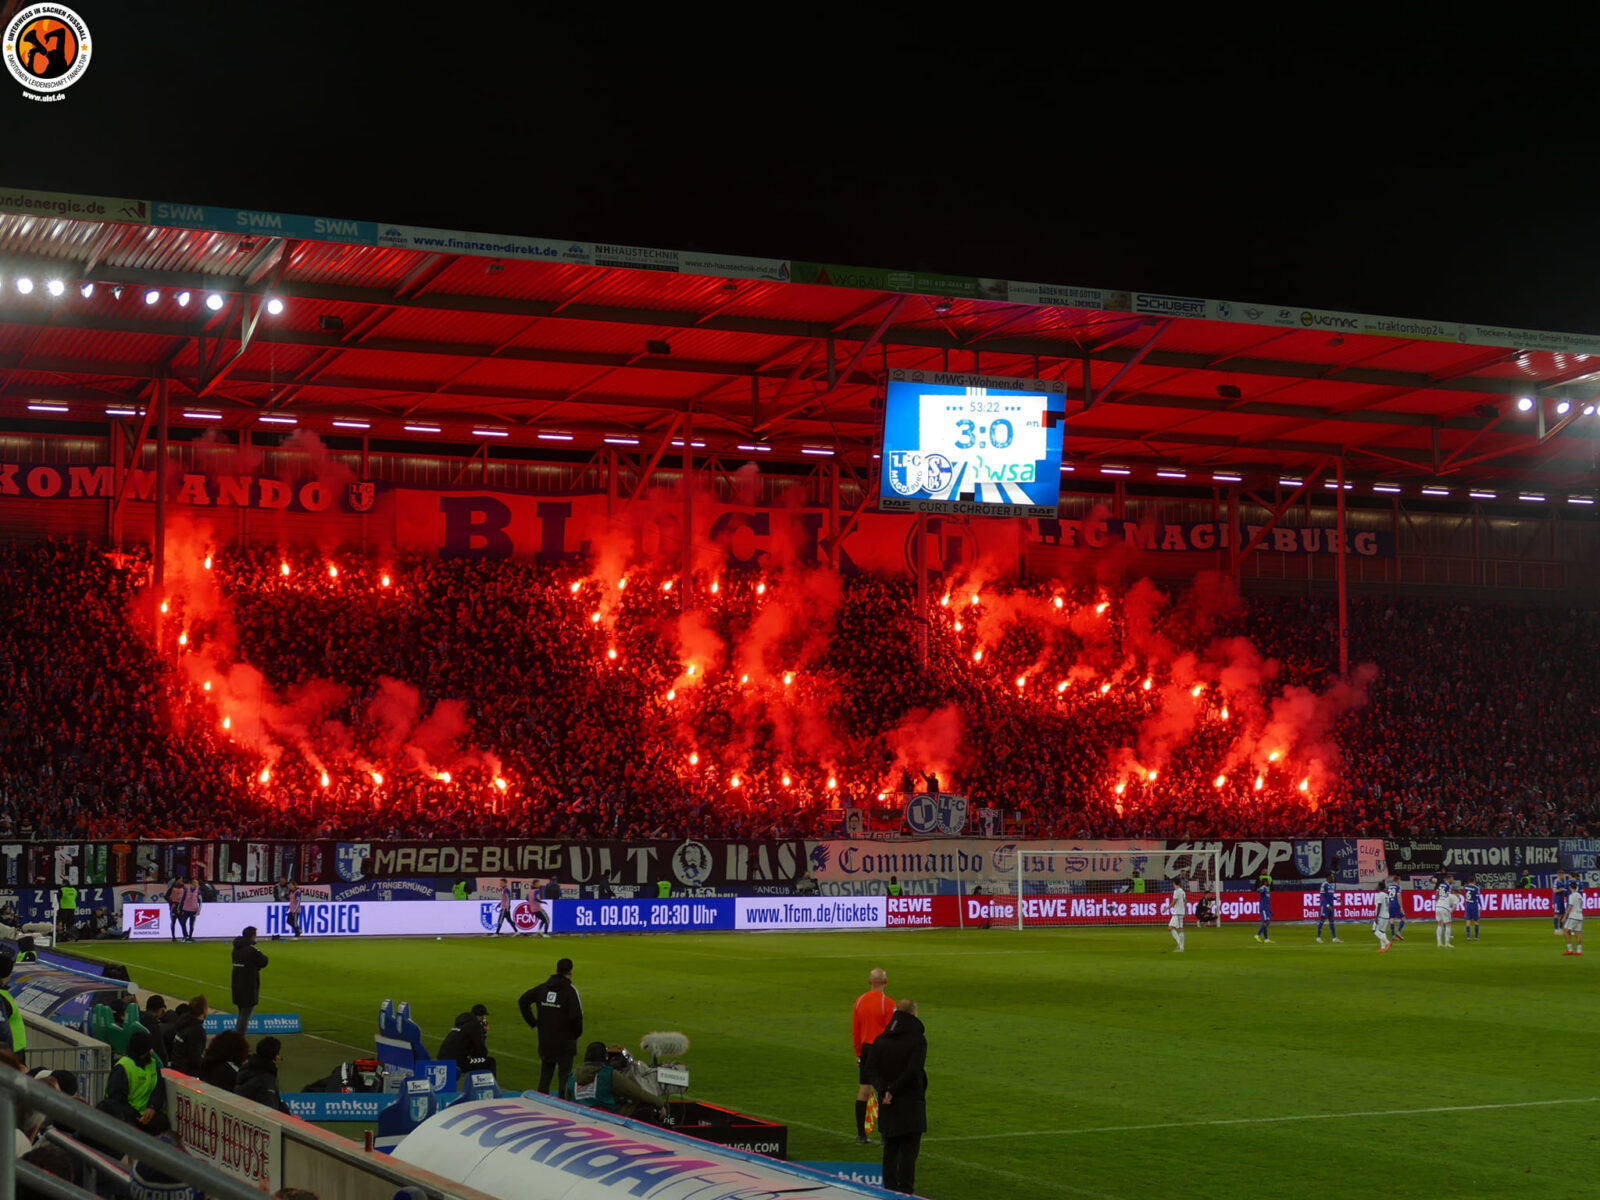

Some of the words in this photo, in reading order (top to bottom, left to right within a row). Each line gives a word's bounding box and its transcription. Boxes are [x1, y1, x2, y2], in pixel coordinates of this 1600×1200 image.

[157, 204, 205, 222] SWM
[236, 211, 282, 229] SWM
[314, 219, 359, 236] SWM
[413, 235, 558, 257] www.finanzen-direkt.de
[1136, 294, 1206, 314] SCHUBERT
[1378, 321, 1444, 336] traktorshop24
[934, 374, 1024, 391] MWG-Wohnen.de
[969, 402, 1000, 413] 53:22
[954, 418, 1014, 449] 3:0
[919, 502, 948, 513] CURT
[953, 502, 1011, 516] SCHRÖTER
[374, 844, 562, 874] MAGDEBURG
[838, 847, 984, 874] Commando
[1443, 846, 1511, 866] SEKTION
[34, 887, 104, 904] ZETZ
[236, 886, 275, 901] SALZWEDE
[377, 881, 434, 897] TANGERMÜNDE
[1465, 891, 1471, 900] 6
[888, 898, 931, 912] REWE
[968, 900, 1014, 919] Deine
[1020, 899, 1067, 918] REWE
[1070, 897, 1124, 918] Märkte
[1130, 902, 1157, 916] aus
[1303, 893, 1341, 907] REE
[1501, 893, 1550, 911] Märkte
[266, 904, 359, 934] HEMSIEG
[516, 914, 536, 924] FCN
[576, 906, 597, 926] Sa.
[600, 905, 647, 928] 09.03.,
[651, 905, 689, 925] 20:30
[693, 904, 718, 925] Uhr
[746, 902, 878, 924] www.1fcm.de/tickets
[888, 915, 905, 924] Dein
[907, 914, 931, 925] Markt
[1303, 908, 1319, 919] Dein
[1345, 908, 1356, 918] Dein
[263, 1018, 299, 1027] mhkw
[325, 1100, 378, 1111] mhkw
[221, 1113, 270, 1179] HOUSE
